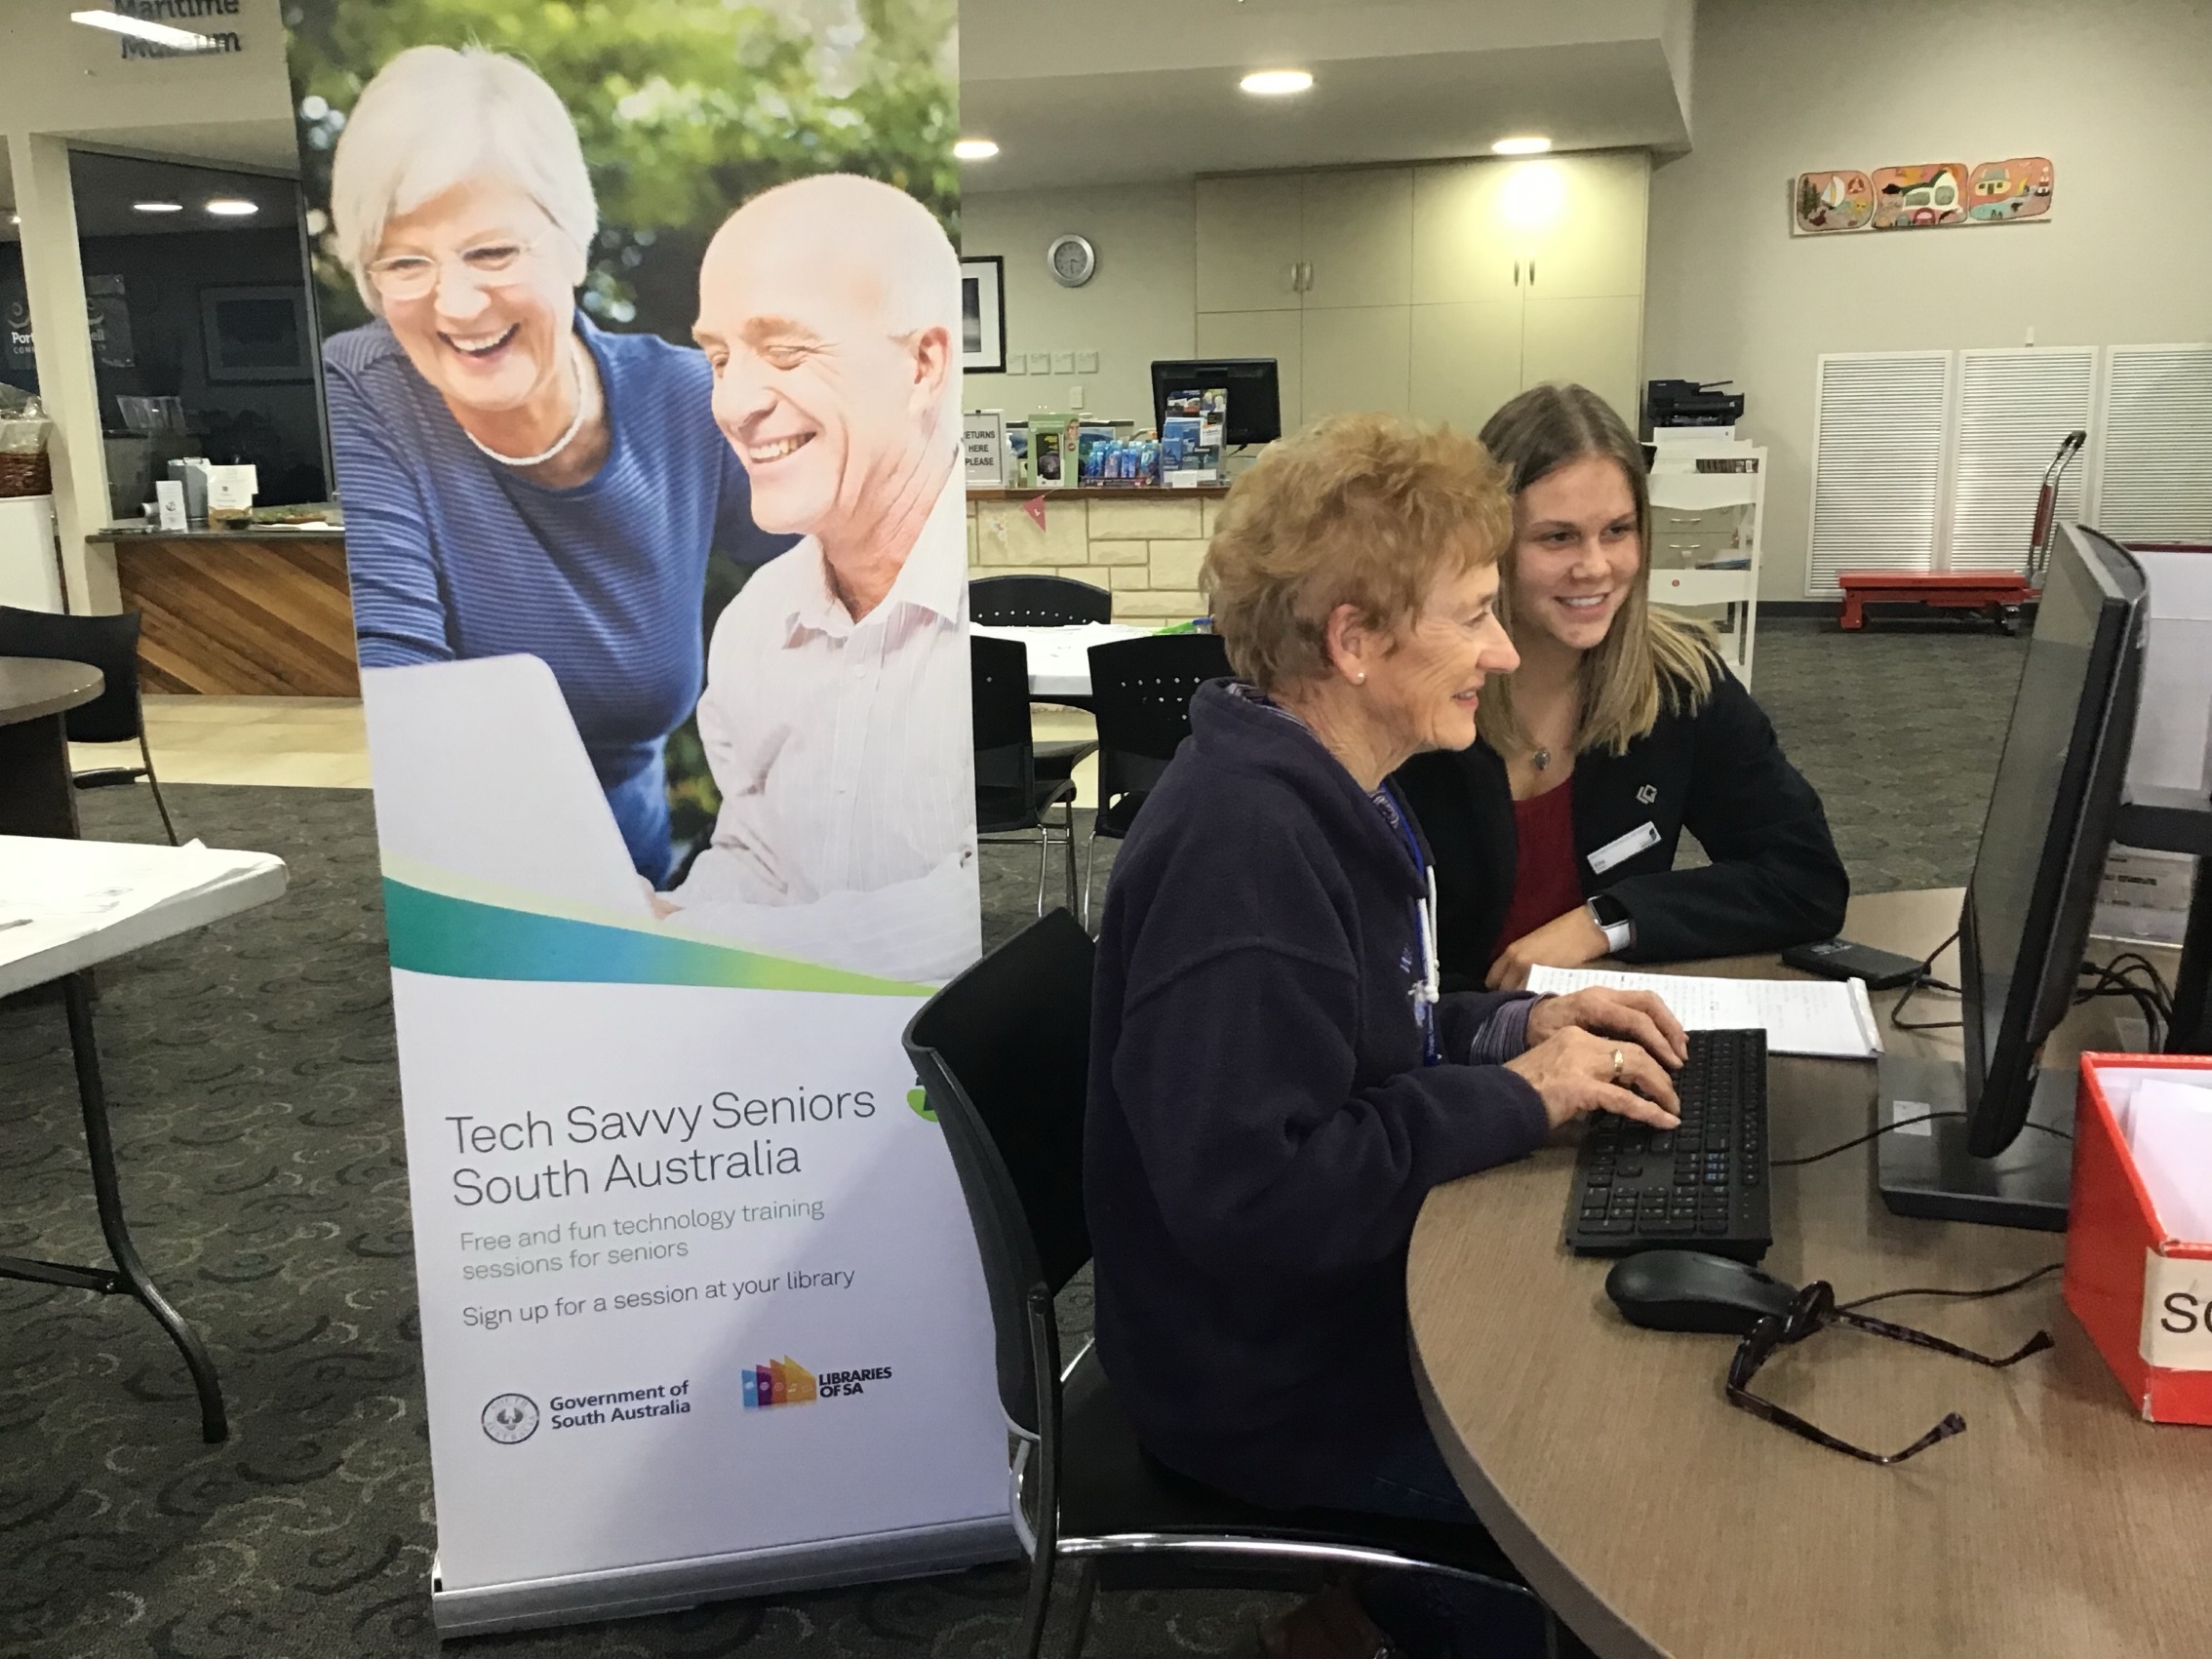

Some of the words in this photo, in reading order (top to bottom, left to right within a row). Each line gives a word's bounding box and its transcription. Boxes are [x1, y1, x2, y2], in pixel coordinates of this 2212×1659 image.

[964, 430, 996, 441] ETURNS
[968, 444, 989, 453] HERE
[965, 456, 994, 466] PLEASE
[445, 1111, 553, 1155] Tech
[568, 1104, 702, 1143] Savvy
[712, 1086, 876, 1130] Seniors
[454, 1160, 589, 1206] South
[604, 1139, 802, 1192] Australia
[461, 1232, 511, 1251] Free
[519, 1224, 561, 1247] and
[569, 1221, 607, 1242] fun
[613, 1208, 735, 1237] technology
[741, 1200, 825, 1222] training
[463, 1256, 563, 1281] sessions
[570, 1249, 602, 1269] for
[608, 1241, 690, 1265] seniors
[463, 1306, 513, 1330] Sign
[520, 1303, 548, 1324] up
[555, 1297, 586, 1317] for
[593, 1296, 607, 1313] a
[614, 1284, 697, 1310] session
[705, 1281, 728, 1298] at
[732, 1276, 780, 1300] your
[787, 1269, 855, 1290] library
[818, 1366, 892, 1386] LIBRARIES
[819, 1385, 842, 1399] OF
[843, 1382, 864, 1397] SA
[549, 1384, 666, 1412] Government
[669, 1379, 690, 1397] of
[551, 1409, 606, 1431] South
[611, 1399, 691, 1423] Australia
